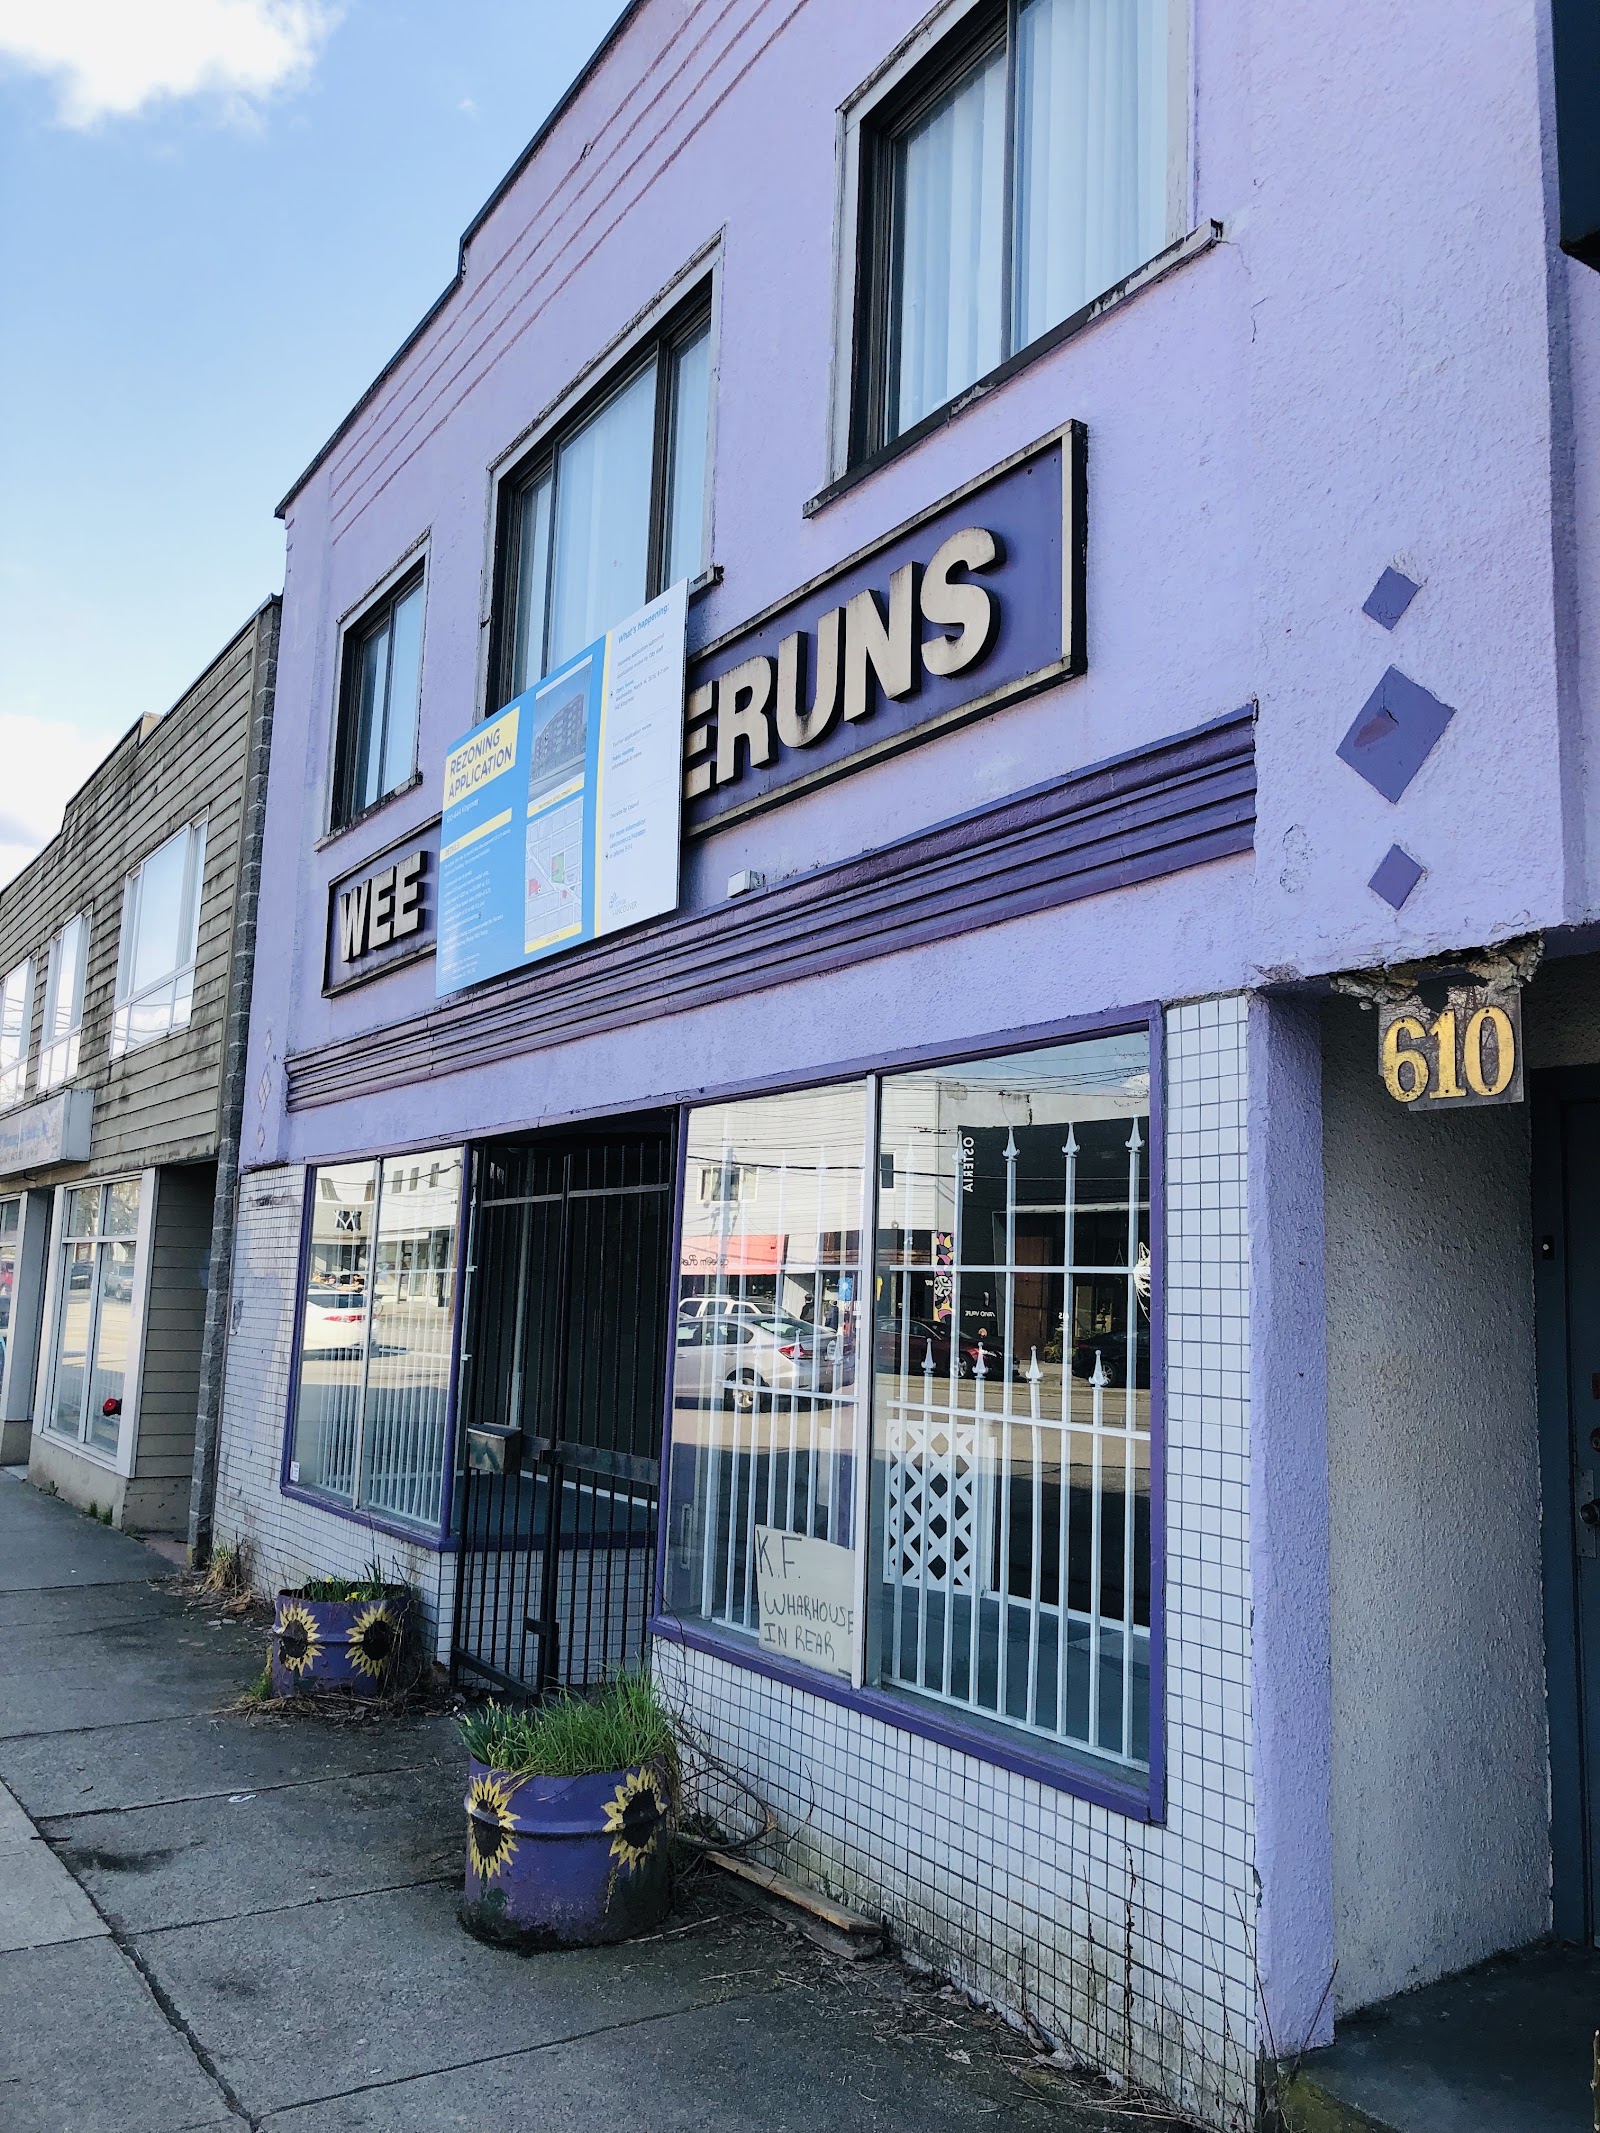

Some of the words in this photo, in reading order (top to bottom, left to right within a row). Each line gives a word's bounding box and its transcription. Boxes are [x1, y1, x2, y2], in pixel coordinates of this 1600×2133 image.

[448, 742, 513, 801] APPLICATION
[450, 728, 500, 777] REZONING
[339, 851, 428, 962] WEE
[1382, 1005, 1515, 1103] 610
[764, 1591, 854, 1635] WHARHOUSE
[764, 1622, 787, 1648] IN
[795, 1624, 835, 1662] REAR
